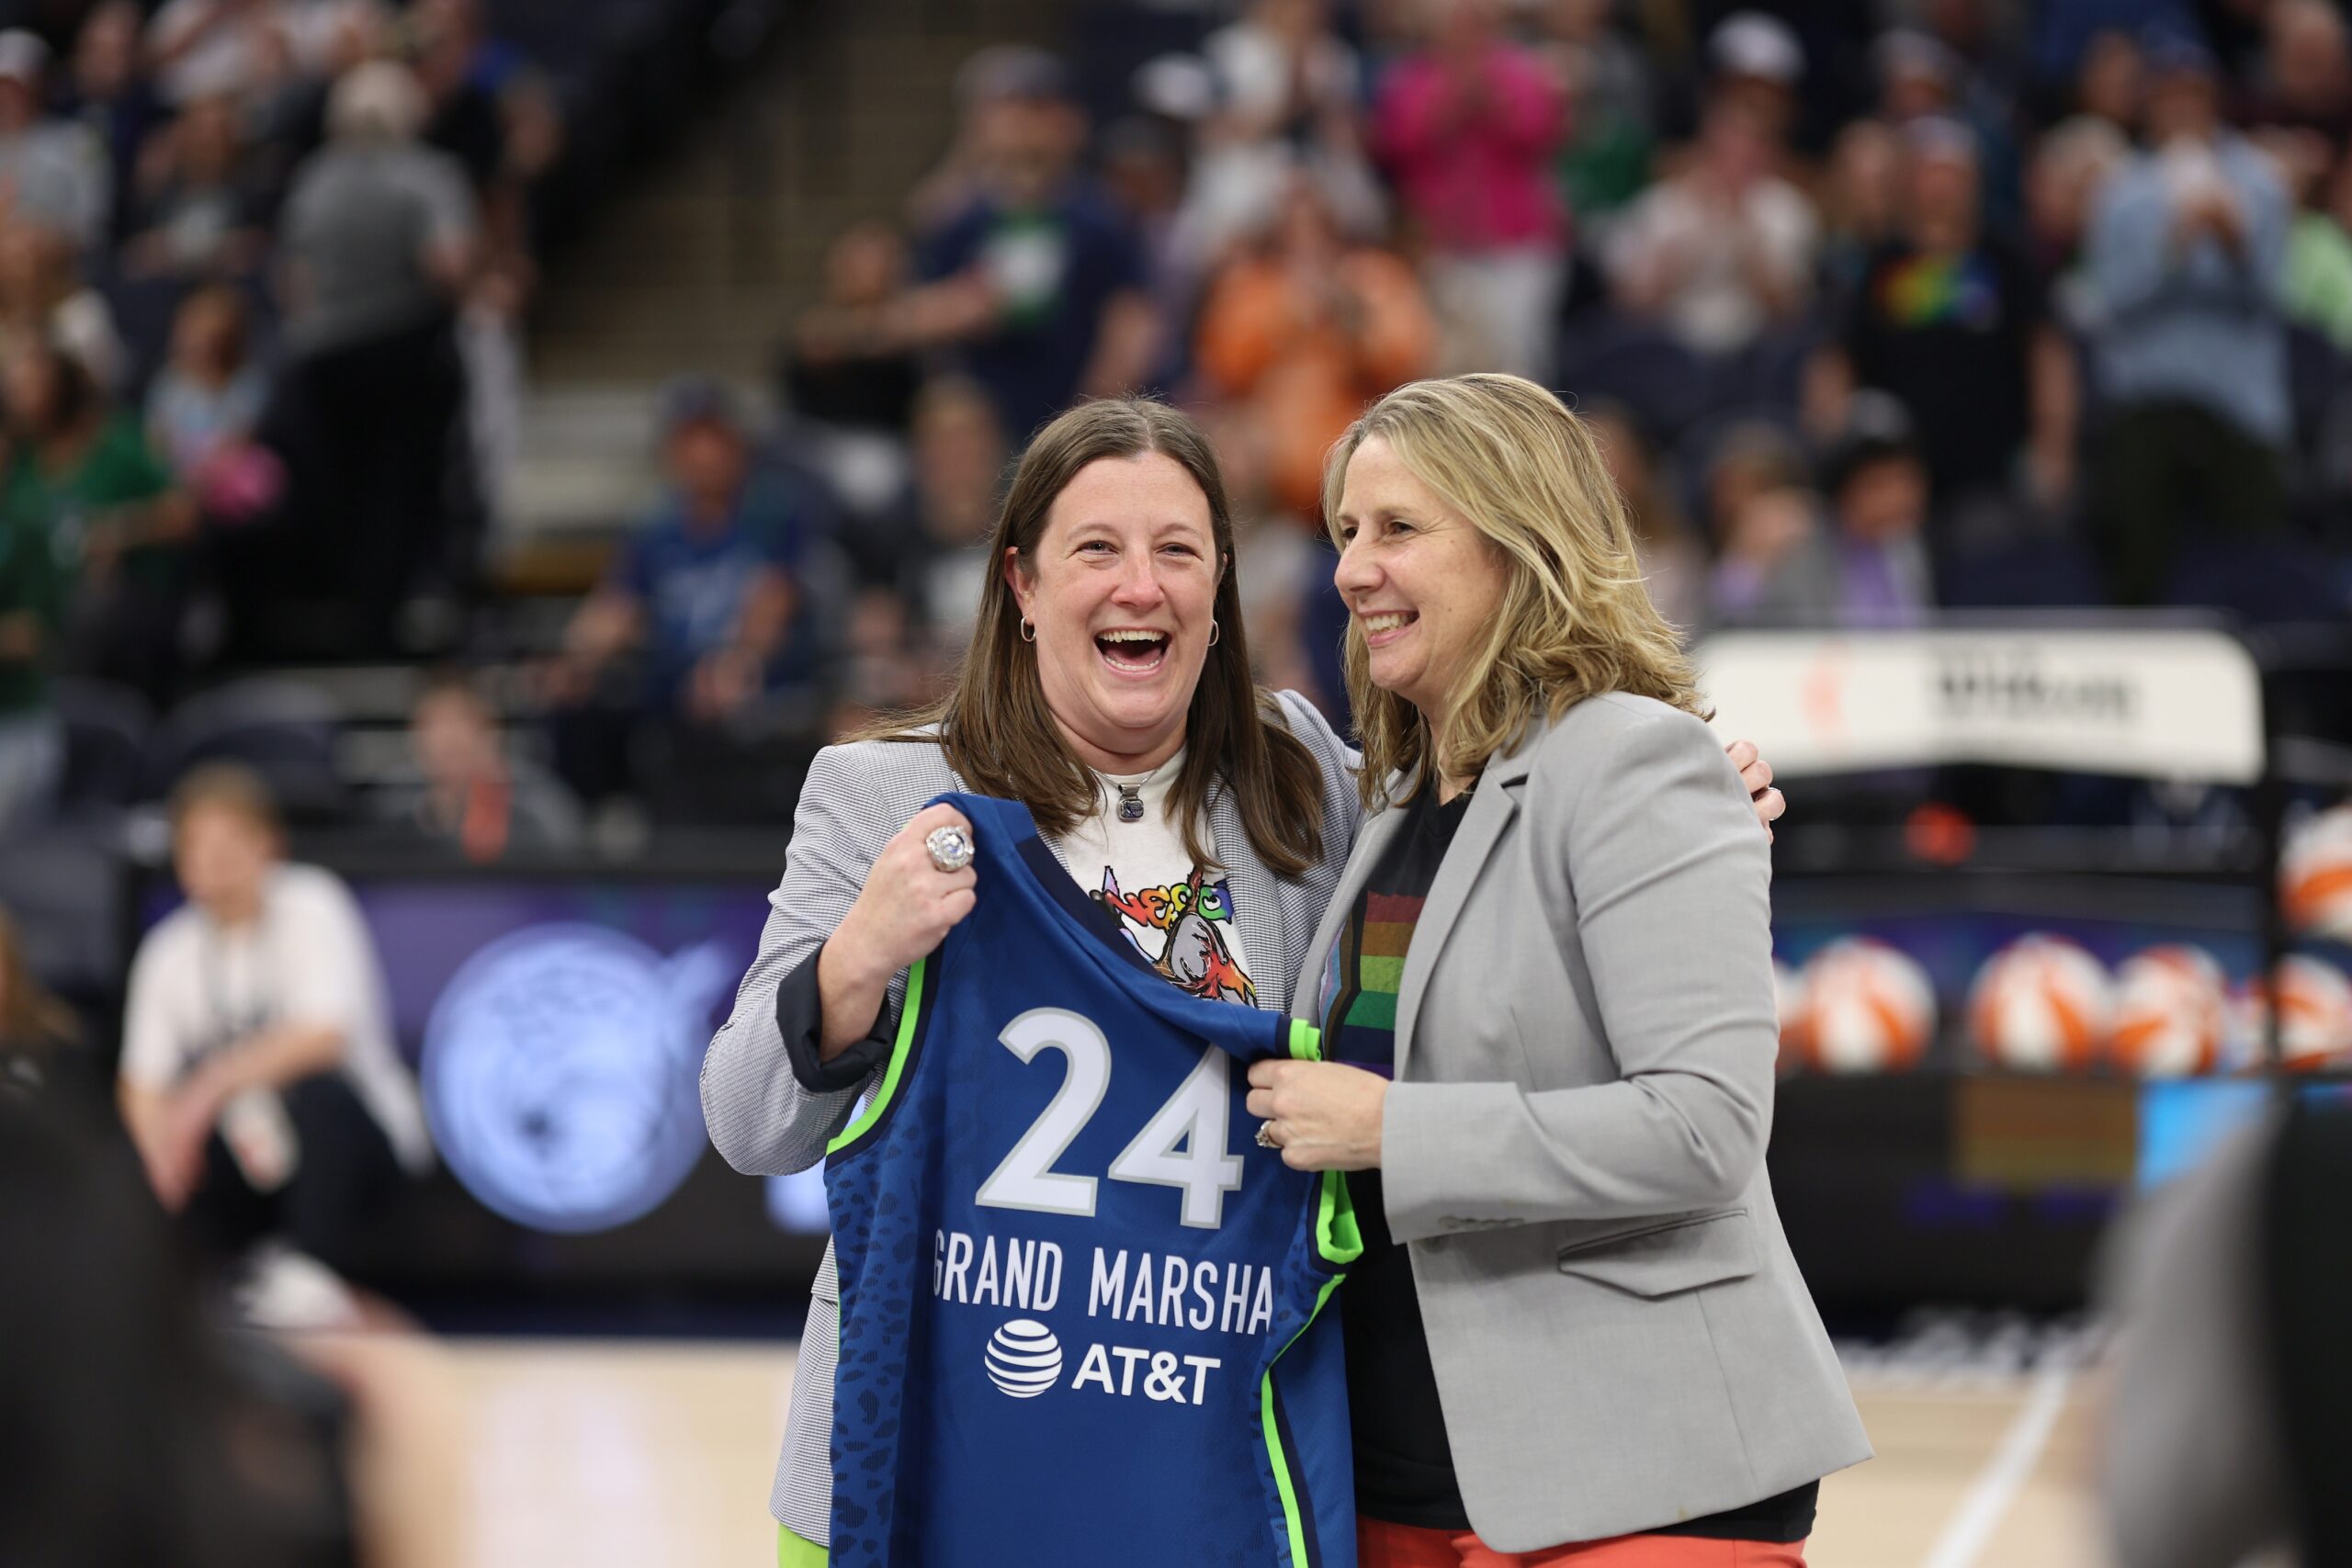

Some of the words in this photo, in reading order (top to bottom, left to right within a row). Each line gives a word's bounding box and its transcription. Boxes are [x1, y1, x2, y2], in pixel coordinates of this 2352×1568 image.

[974, 1007, 1244, 1229] 24
[933, 1228, 1063, 1312] GRAND
[1088, 1247, 1273, 1336] MARSHA
[1071, 1342, 1222, 1406] AT&T
